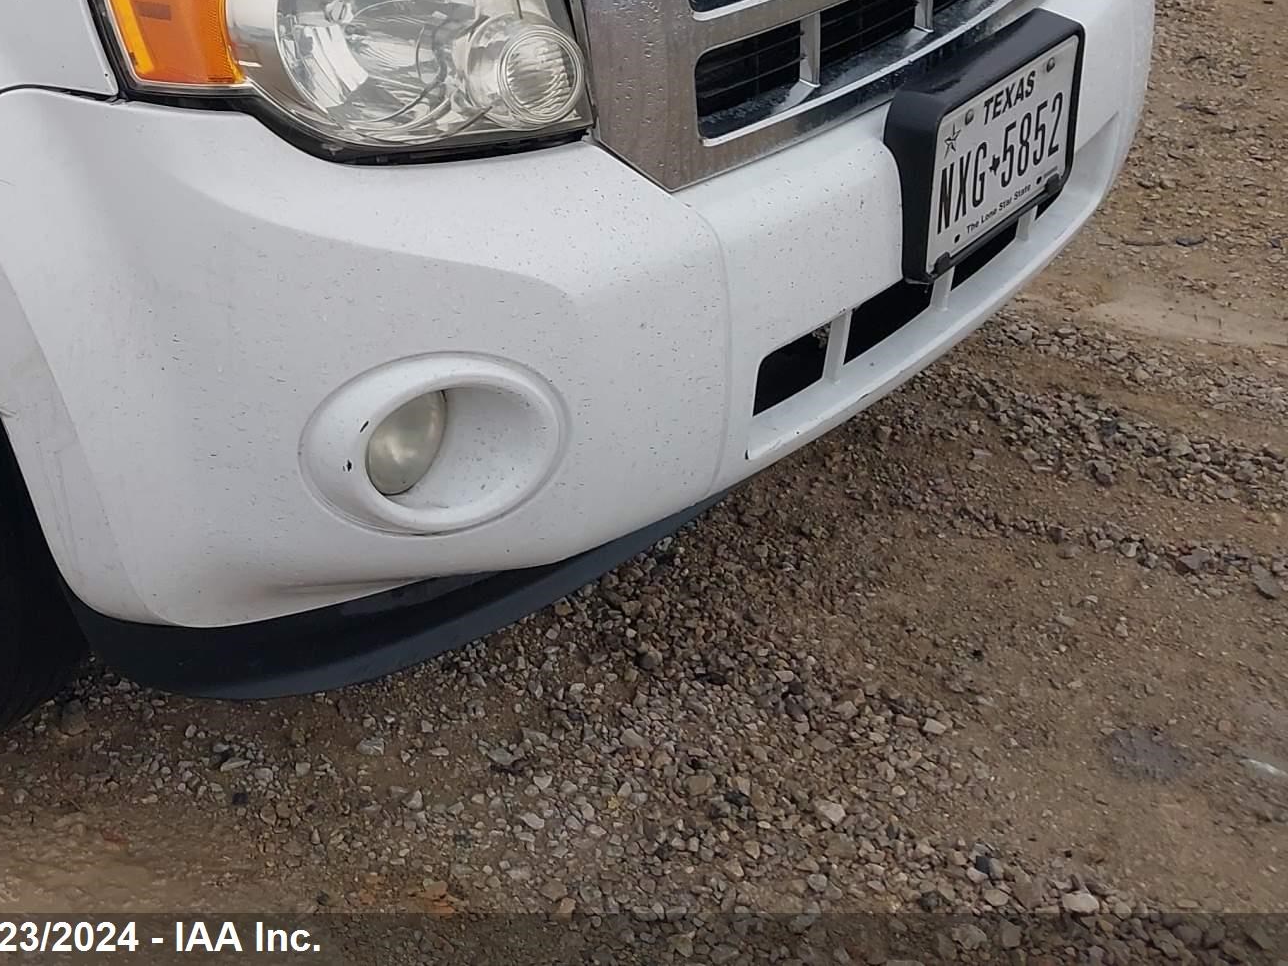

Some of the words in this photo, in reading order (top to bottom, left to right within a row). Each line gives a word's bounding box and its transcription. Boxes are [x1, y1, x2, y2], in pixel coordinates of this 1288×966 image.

[983, 71, 1036, 125] TEXAS
[966, 221, 979, 234] The
[981, 208, 997, 223] Lone
[998, 197, 1012, 211] Star
[1014, 185, 1031, 201] State
